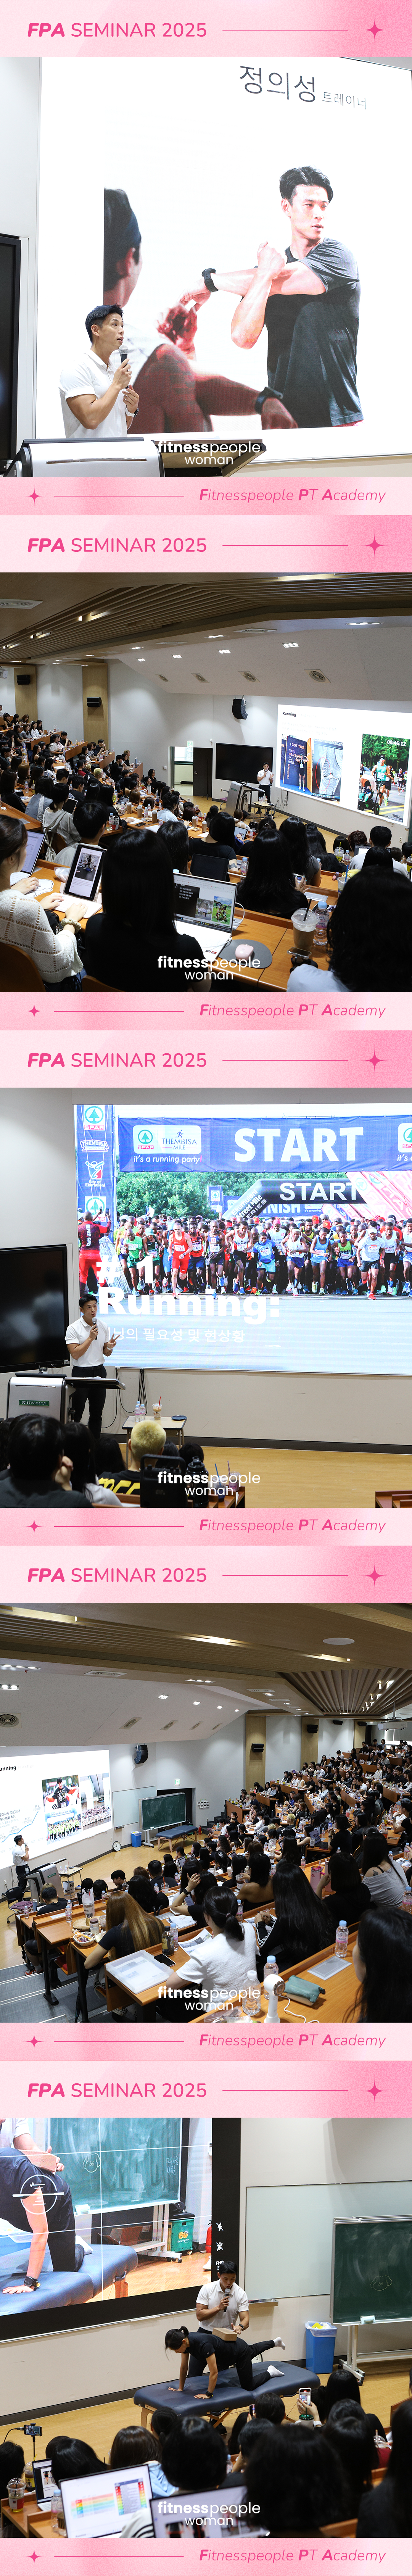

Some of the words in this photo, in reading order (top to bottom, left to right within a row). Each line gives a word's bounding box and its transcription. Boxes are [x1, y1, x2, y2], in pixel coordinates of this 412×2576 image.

[240, 66, 315, 102] 정의성
[322, 92, 366, 110] 트레이너
[234, 1127, 363, 1162] START
[153, 1156, 180, 1164] running
[181, 1155, 202, 1164] party!
[249, 1195, 262, 1207] Mile
[279, 1182, 357, 1201] START
[245, 1199, 267, 1219] ERIES
[263, 1203, 301, 1214] INISH
[136, 1256, 153, 1284] 1
[99, 1286, 280, 1325] Running:
[108, 1327, 138, 1341] 닝의
[143, 1328, 183, 1341] 필요성
[187, 1329, 200, 1343] 및
[204, 1329, 245, 1343] 현상황
